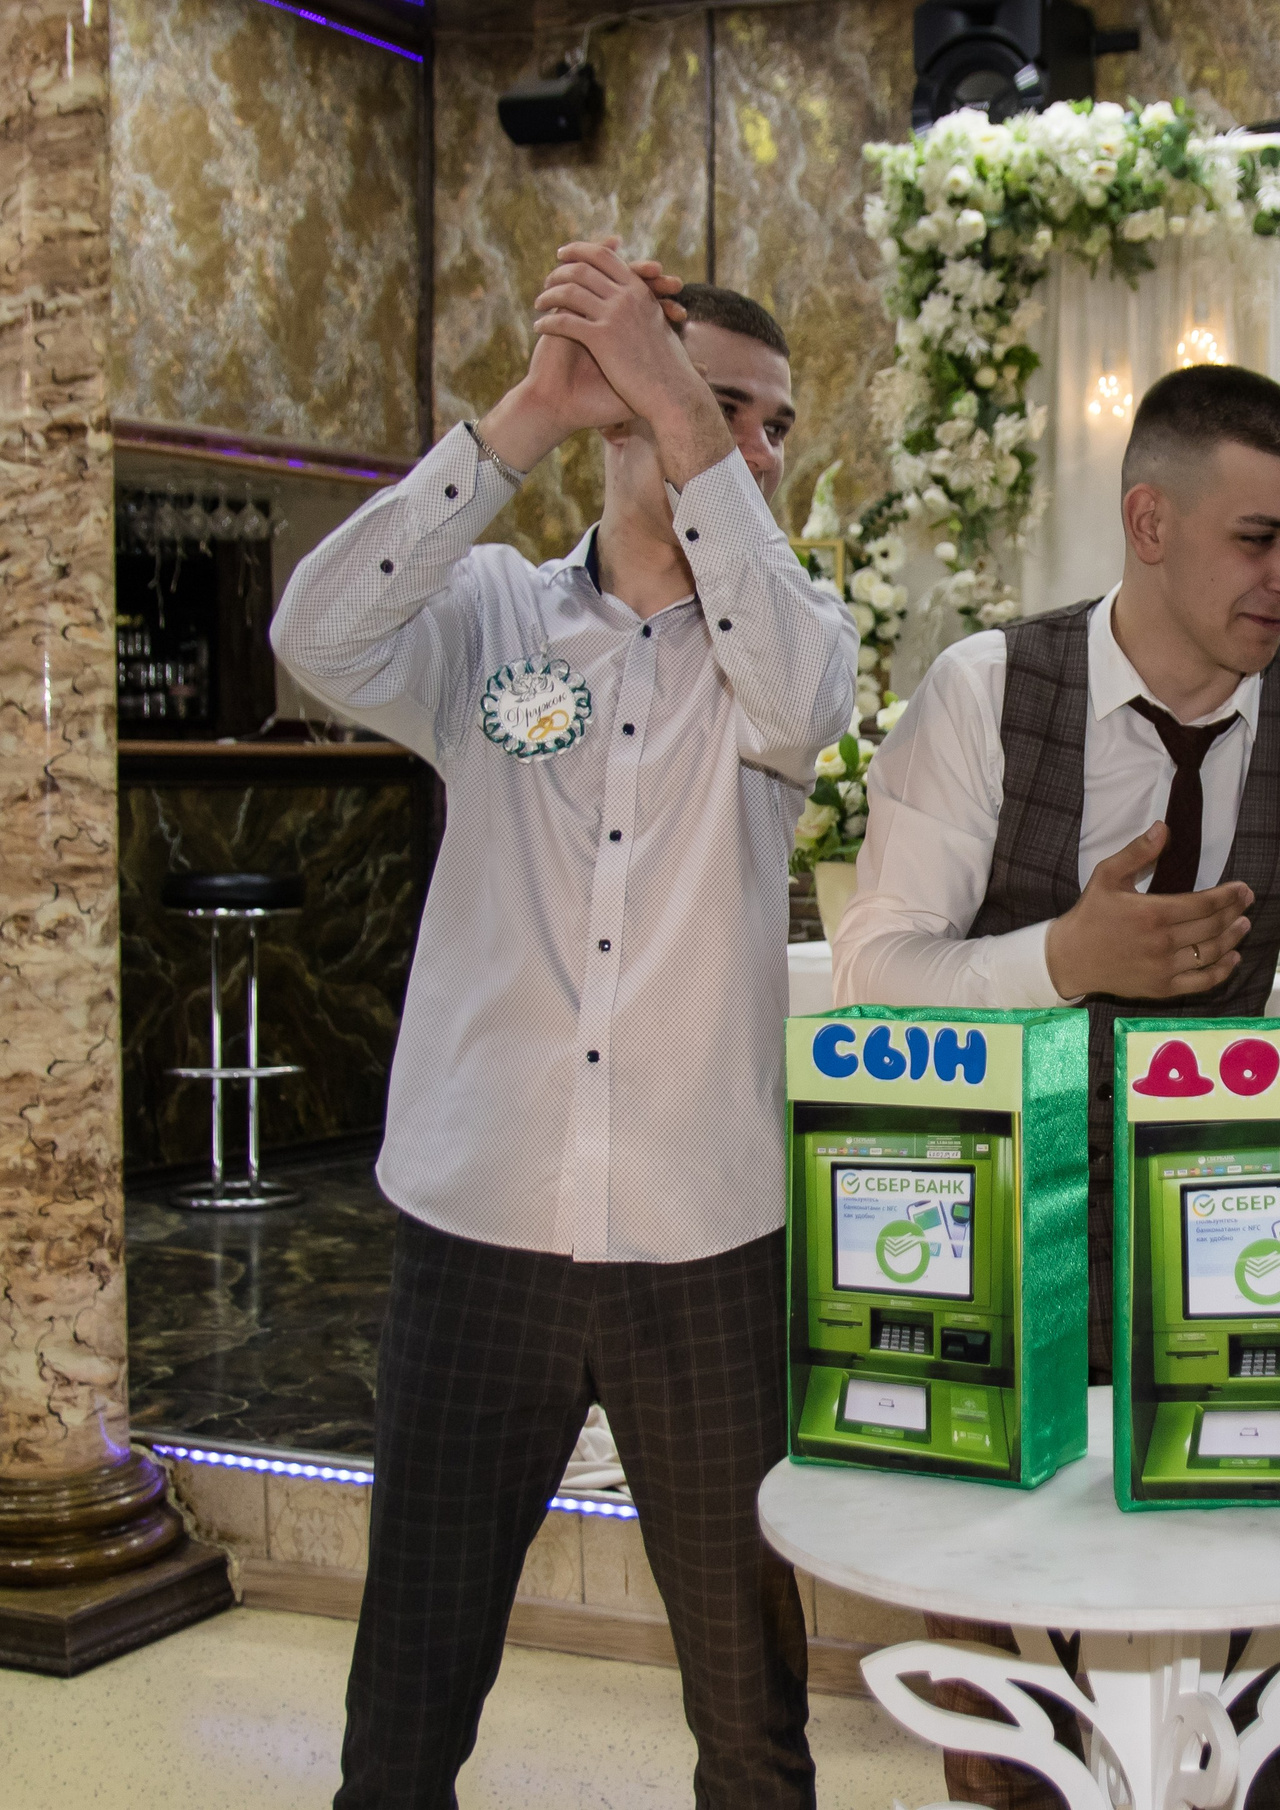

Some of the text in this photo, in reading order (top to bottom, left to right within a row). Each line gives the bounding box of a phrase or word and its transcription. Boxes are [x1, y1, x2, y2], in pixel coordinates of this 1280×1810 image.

[504, 692, 568, 728] Дружок
[812, 1023, 987, 1085] СЫН
[865, 1177, 964, 1194] СБЕР БАНК
[1221, 1195, 1276, 1212] СБЕР
